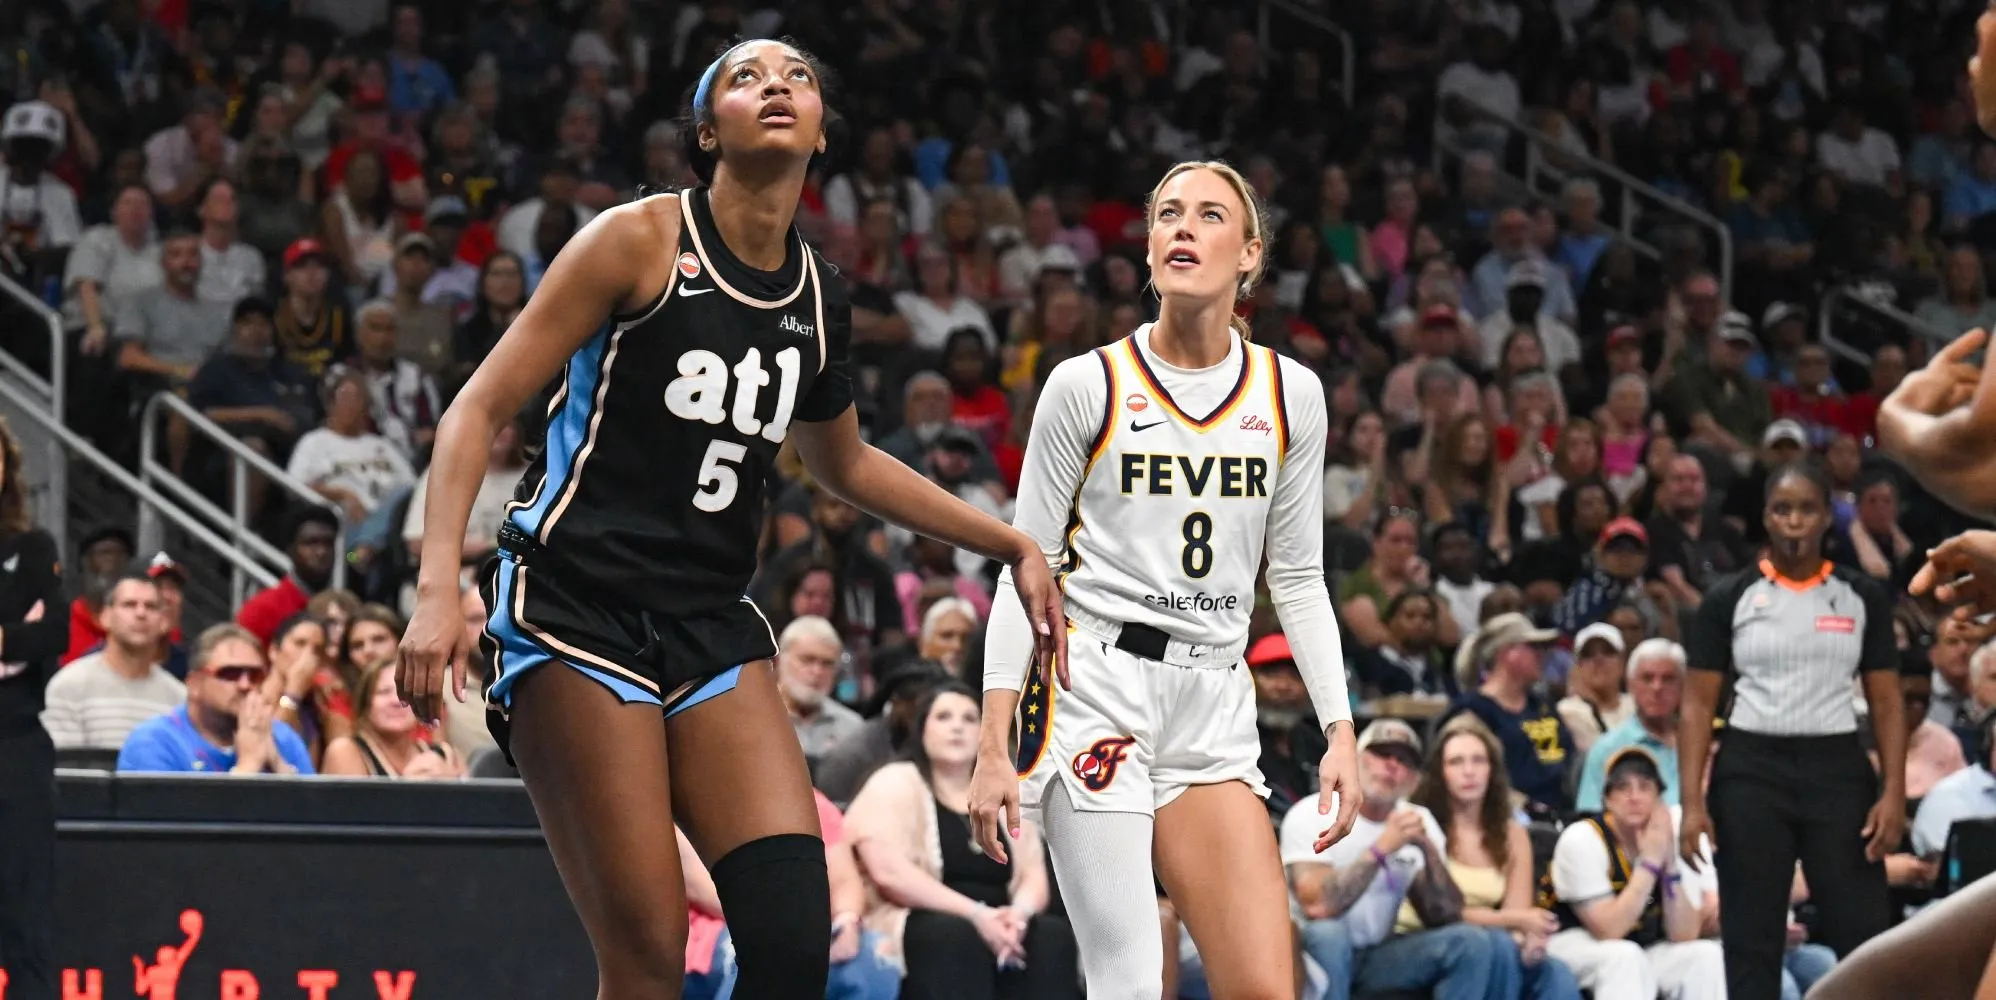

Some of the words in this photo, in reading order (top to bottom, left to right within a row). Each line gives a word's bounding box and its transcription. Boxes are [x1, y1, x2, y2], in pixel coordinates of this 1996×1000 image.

[780, 314, 814, 338] Albert
[664, 347, 800, 443] atl
[1239, 414, 1273, 436] Lilly
[692, 438, 748, 512] 5
[1119, 453, 1268, 498] FEVER
[1181, 509, 1213, 580] 8
[1144, 591, 1237, 614] salesforce
